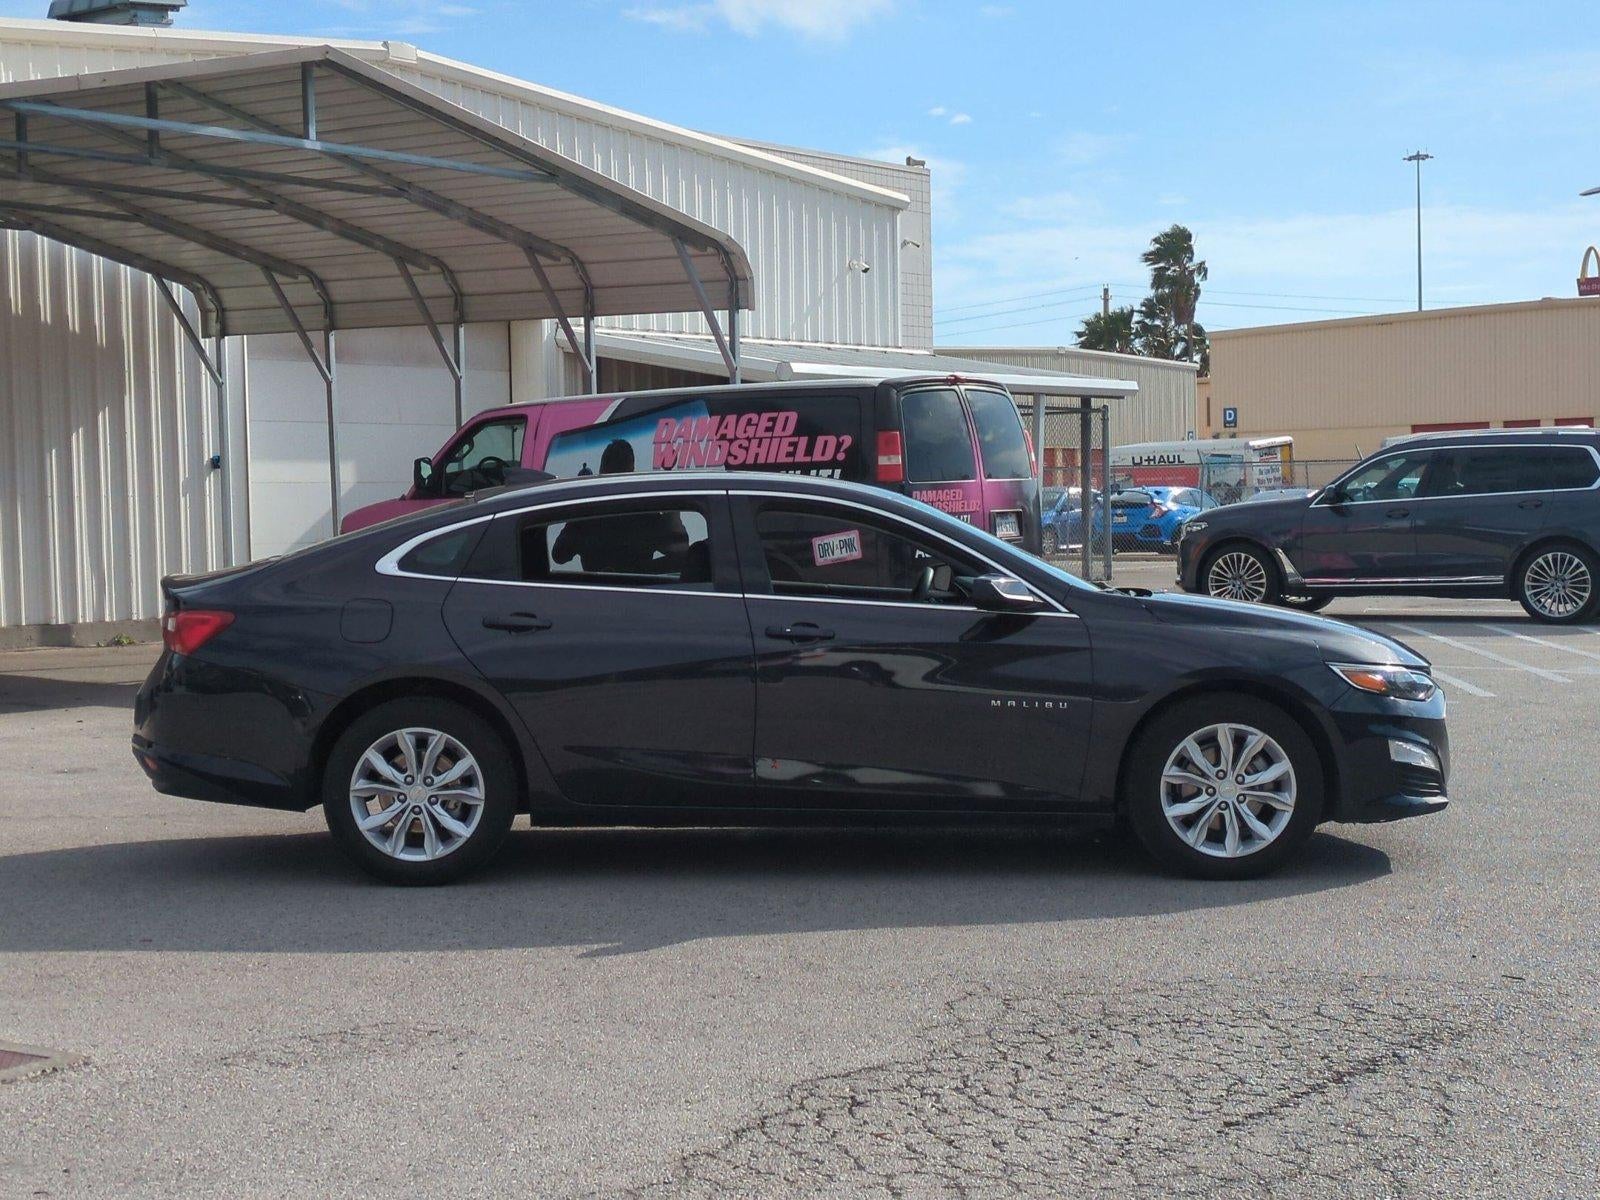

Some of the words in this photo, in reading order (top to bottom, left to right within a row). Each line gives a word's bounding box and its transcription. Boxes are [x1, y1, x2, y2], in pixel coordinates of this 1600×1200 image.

[1226, 410, 1235, 421] D
[653, 411, 798, 442] DAMAGED
[652, 435, 853, 470] WINDSHIELD?
[1131, 454, 1185, 466] U-HAUL
[912, 489, 963, 502] DAMAGED
[990, 700, 1068, 709] MALIBU
